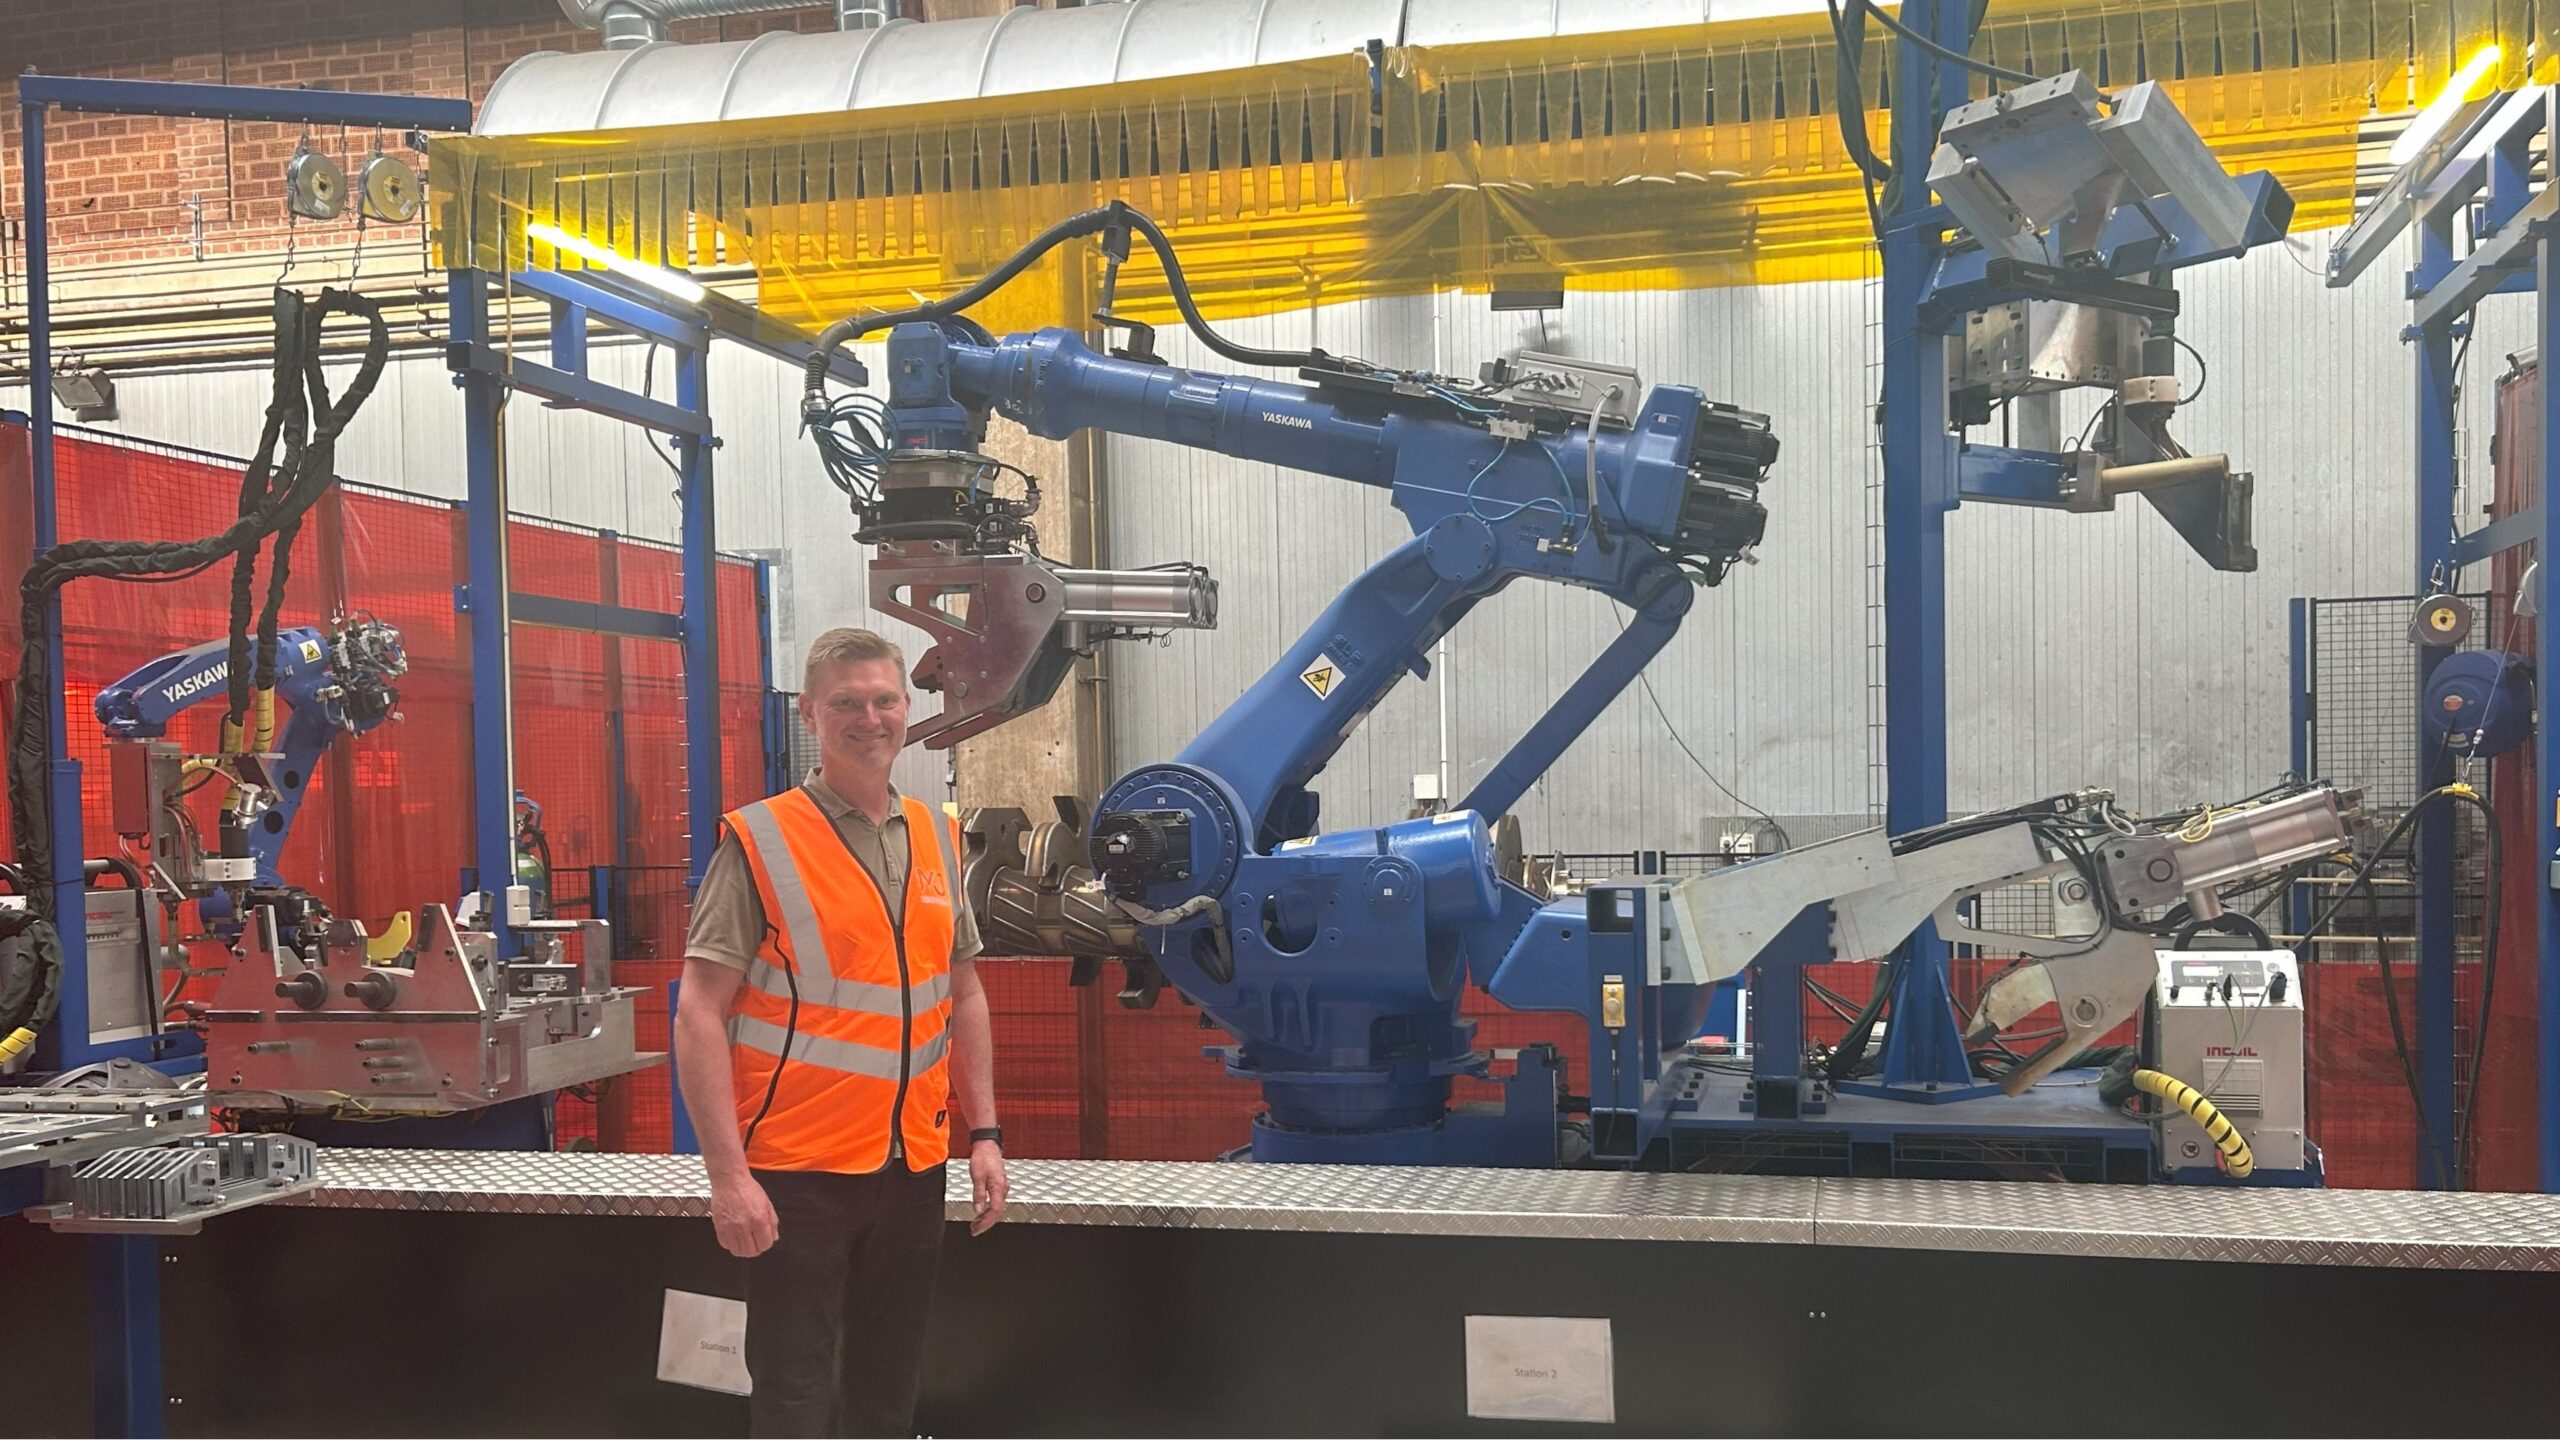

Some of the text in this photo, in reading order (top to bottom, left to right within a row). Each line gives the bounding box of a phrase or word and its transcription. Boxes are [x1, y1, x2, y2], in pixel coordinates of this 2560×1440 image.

[1262, 411, 1312, 430] YASKAWA
[161, 660, 229, 703] YASKAW
[700, 1340, 730, 1353] Station
[1514, 1367, 1557, 1379] Station 2
